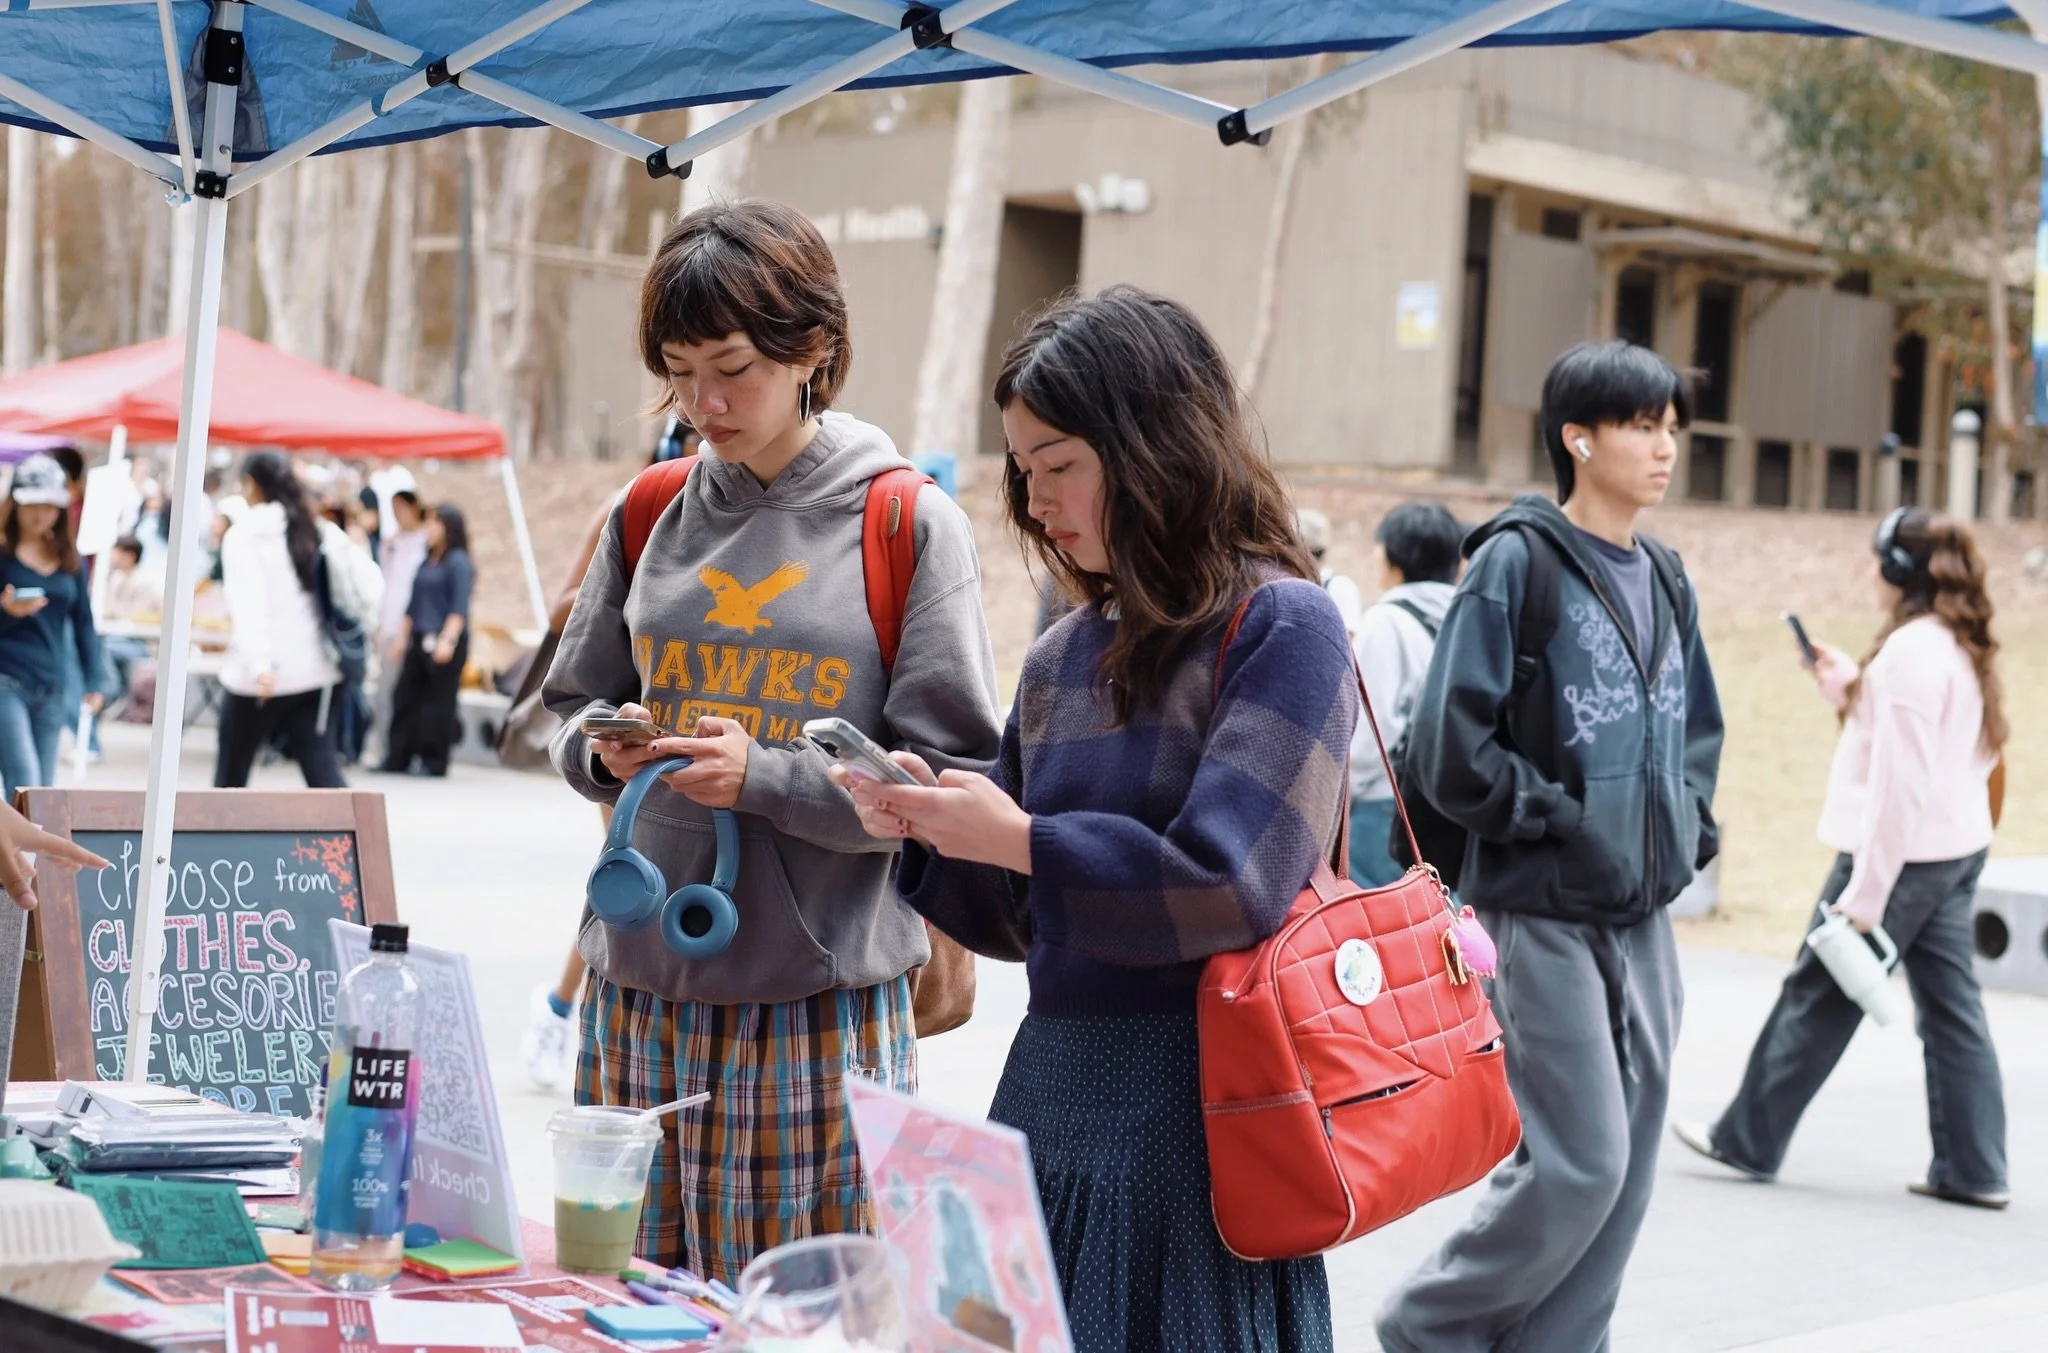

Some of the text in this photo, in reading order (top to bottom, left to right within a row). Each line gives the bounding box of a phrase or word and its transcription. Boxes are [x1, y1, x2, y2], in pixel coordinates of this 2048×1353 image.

[274, 857, 336, 894] from
[88, 909, 312, 974] CLTHES,
[90, 970, 338, 1033] ACESORIE
[355, 1057, 406, 1078] LIFE
[354, 1080, 404, 1100] WTR
